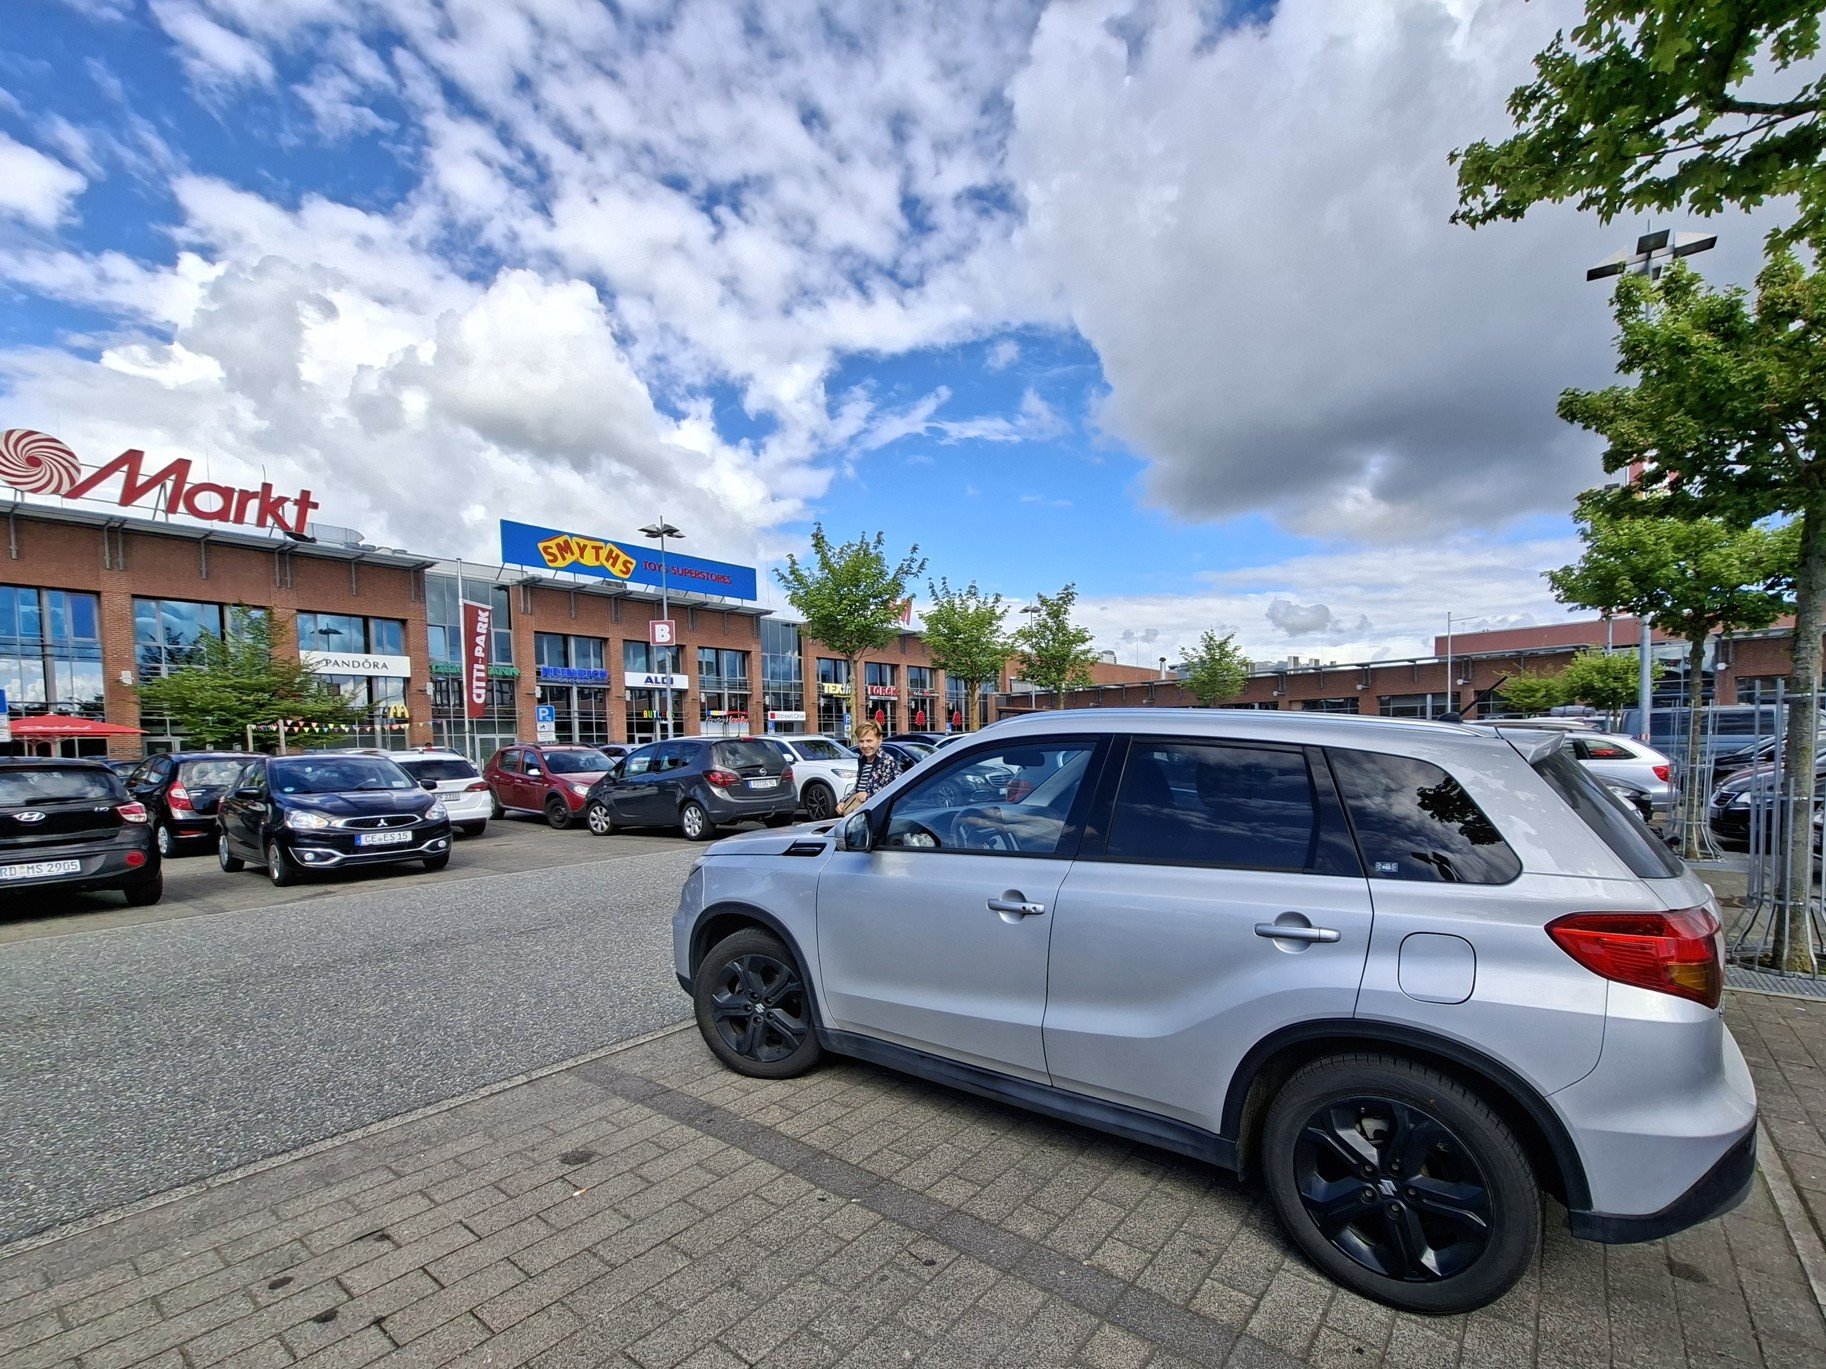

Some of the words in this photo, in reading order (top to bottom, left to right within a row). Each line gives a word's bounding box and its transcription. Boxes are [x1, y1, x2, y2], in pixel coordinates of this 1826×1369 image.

[61, 448, 320, 535] Markt
[541, 539, 635, 577] SMYTHS
[643, 560, 669, 574] TOYS
[670, 565, 733, 584] SUPERSTORES
[655, 624, 671, 643] B
[473, 609, 490, 704] CITTI-PARK
[644, 675, 674, 685] ALDI
[538, 708, 549, 721] P
[643, 710, 675, 719] BUTLES
[776, 712, 793, 720] Street
[364, 834, 377, 843] CE
[383, 833, 396, 842] ES
[397, 832, 408, 840] 15
[0, 867, 17, 877] RD
[26, 865, 43, 875] MS
[47, 861, 78, 873] 2905
